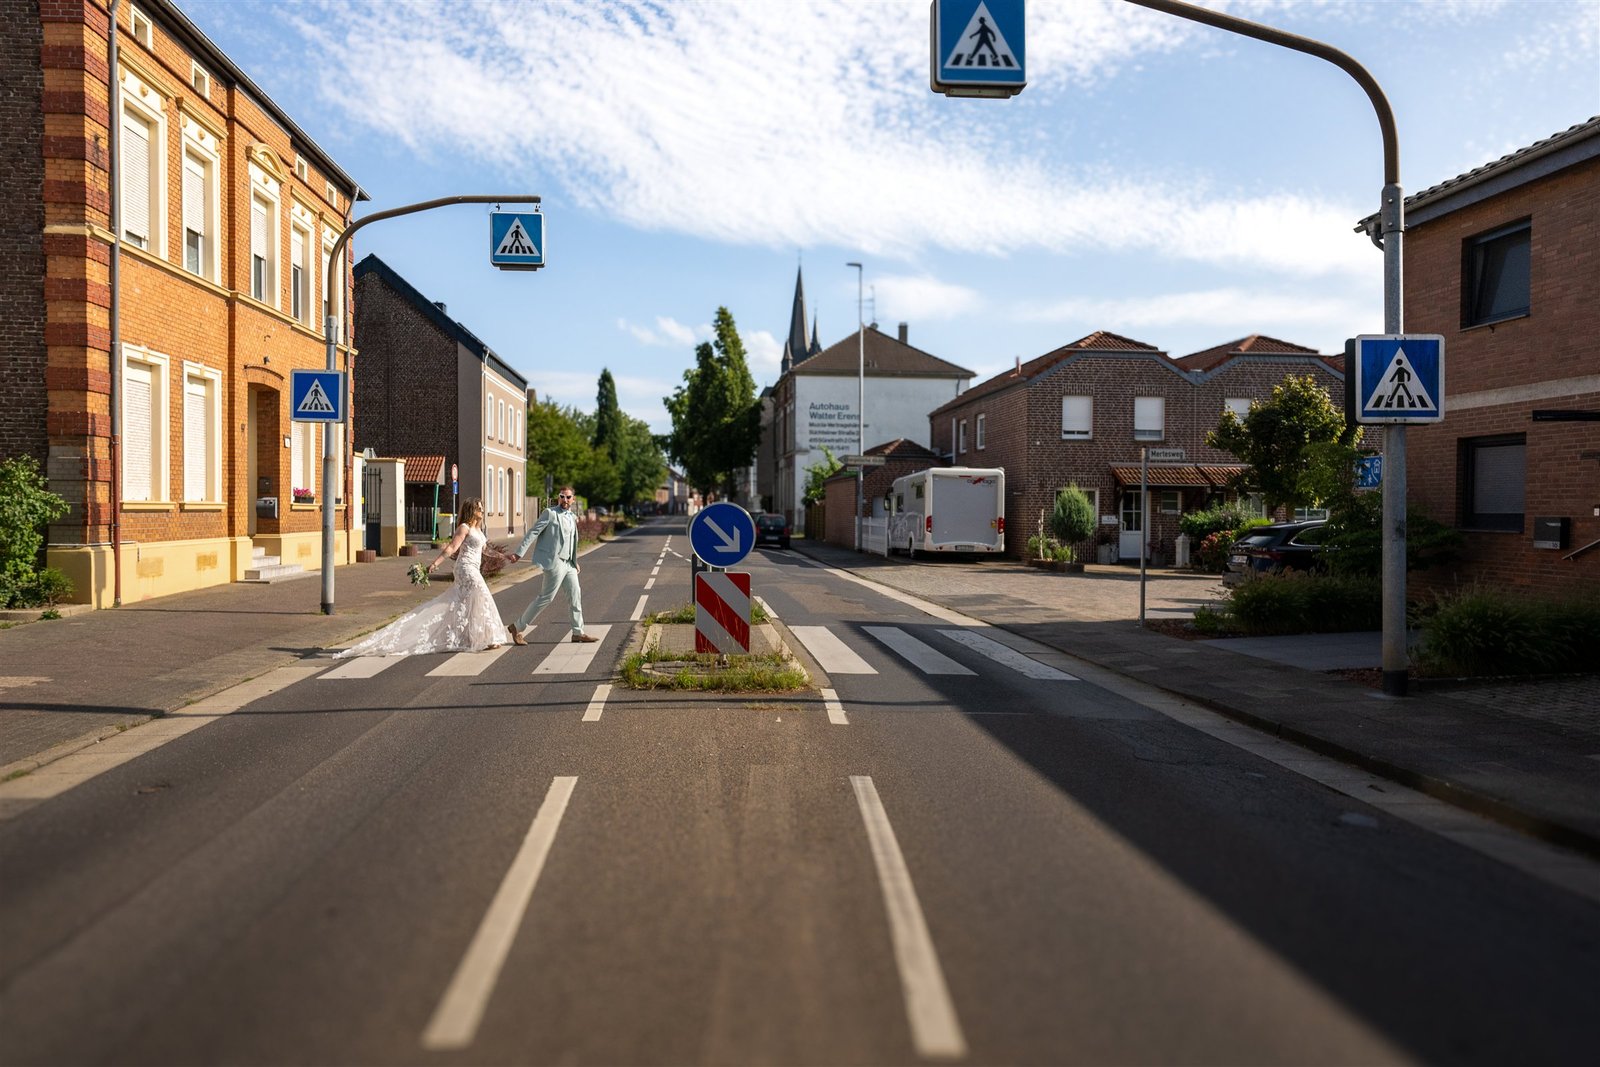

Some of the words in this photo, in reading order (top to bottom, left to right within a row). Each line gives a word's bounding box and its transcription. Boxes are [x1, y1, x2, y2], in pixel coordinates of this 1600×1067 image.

[809, 402, 850, 410] Autohaus
[809, 411, 836, 420] Walter
[1150, 450, 1184, 460] Mertesweg
